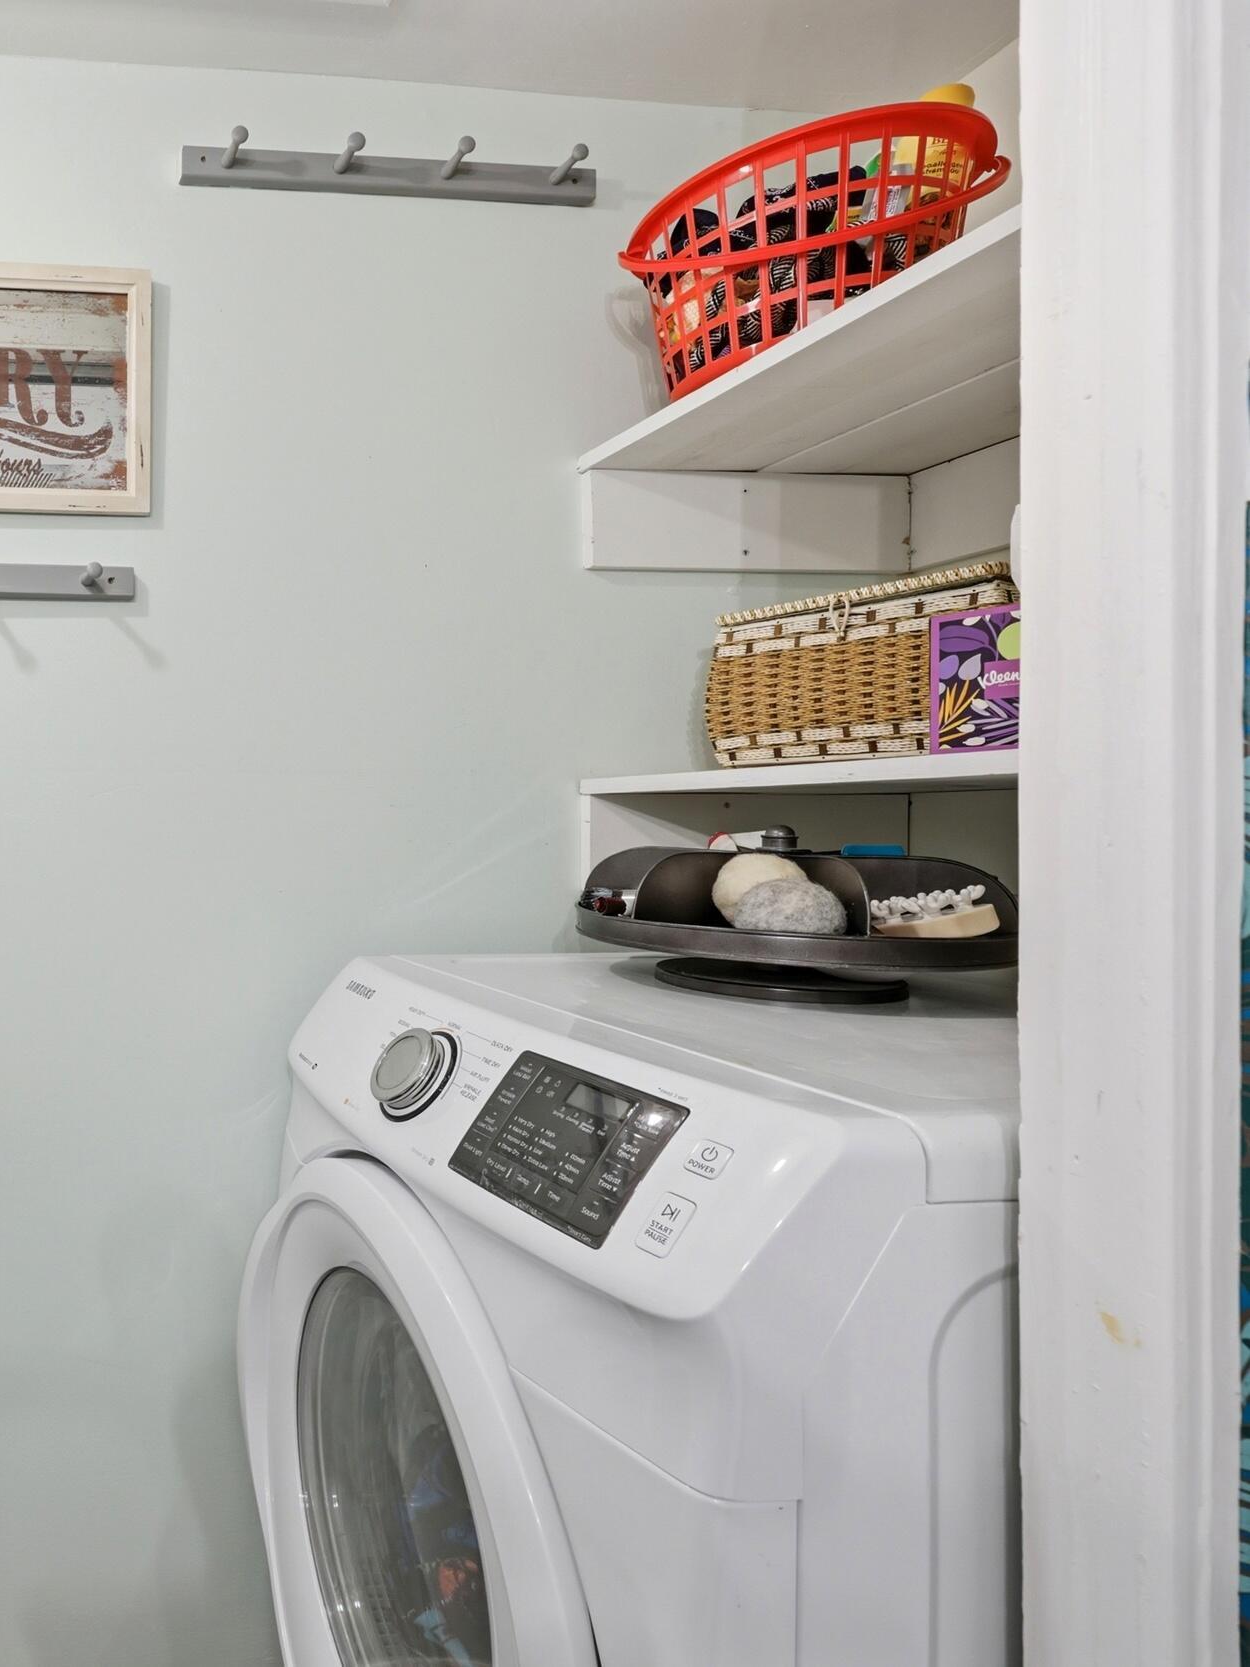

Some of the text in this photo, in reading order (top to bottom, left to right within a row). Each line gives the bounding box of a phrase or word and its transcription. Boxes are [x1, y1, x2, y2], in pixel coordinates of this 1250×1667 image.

[688, 1158, 716, 1175] POWER
[580, 1206, 600, 1221] Sound
[649, 1219, 674, 1236] START
[644, 1229, 668, 1246] PAUSE
